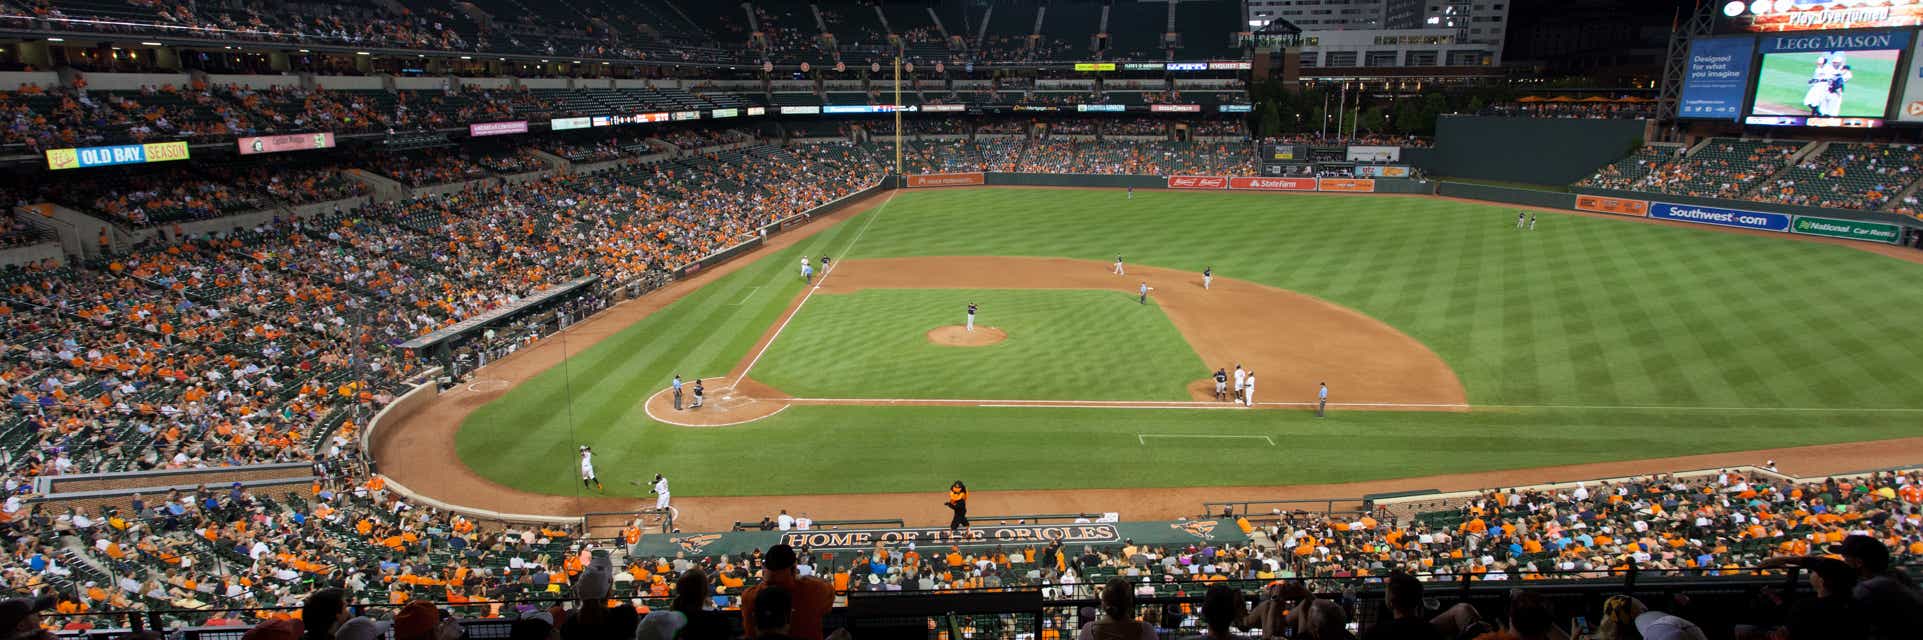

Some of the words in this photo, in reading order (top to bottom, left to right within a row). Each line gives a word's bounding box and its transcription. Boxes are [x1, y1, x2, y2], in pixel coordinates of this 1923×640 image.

[1776, 36, 1821, 50] LEGG
[1826, 35, 1892, 48] MASON
[1694, 55, 1731, 63] Designed
[1707, 70, 1740, 78] imagine
[82, 149, 111, 164] OLD
[114, 147, 140, 161] BAY
[149, 143, 186, 159] SEASON
[1809, 220, 1850, 233] National
[1853, 227, 1869, 235] Car
[788, 532, 872, 547] HOME
[881, 531, 919, 545] OF
[994, 526, 1114, 542] ORIOLES
